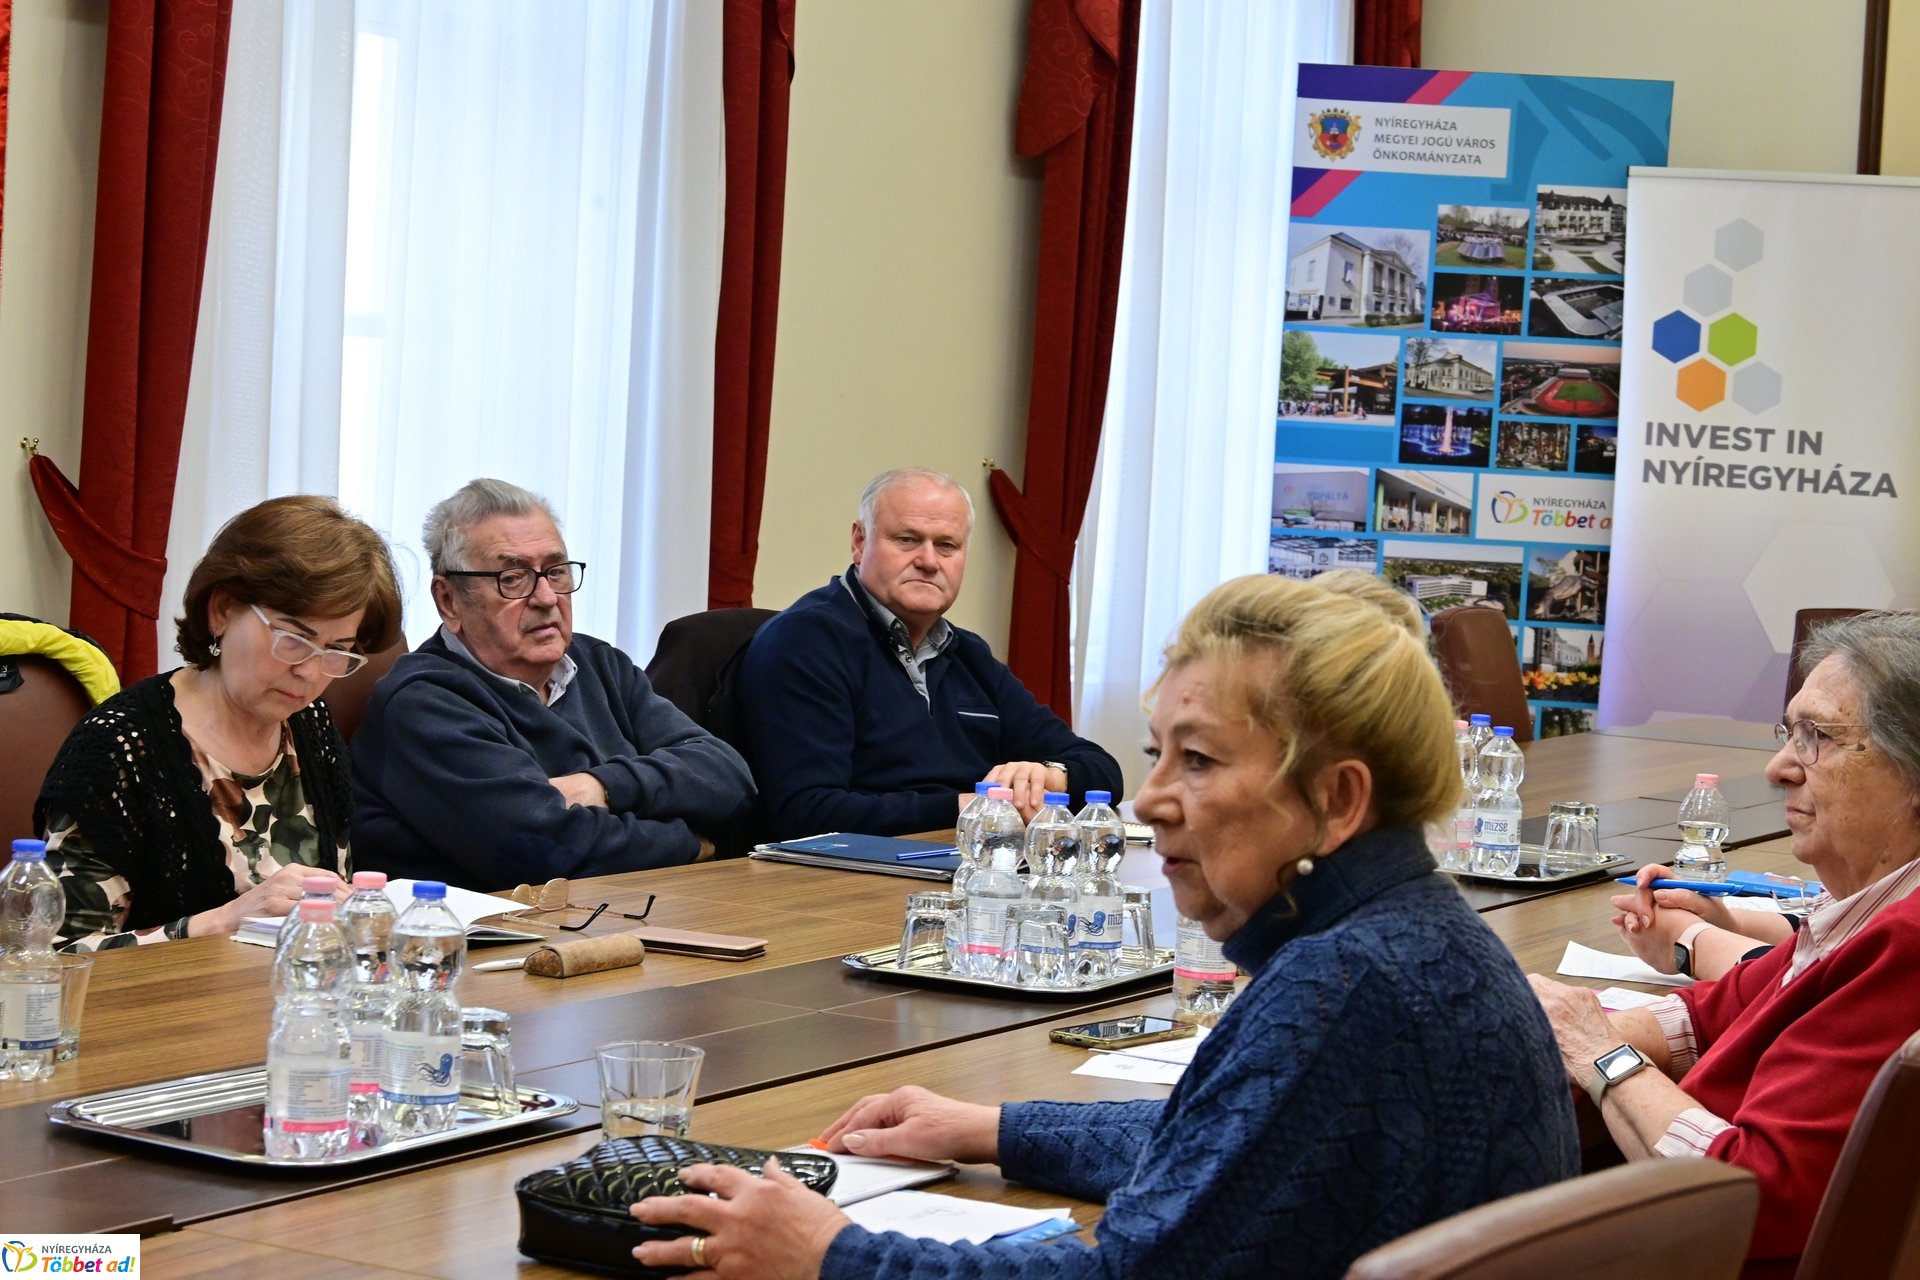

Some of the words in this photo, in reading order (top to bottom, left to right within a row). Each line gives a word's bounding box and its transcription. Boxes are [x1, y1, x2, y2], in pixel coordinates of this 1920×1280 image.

[1375, 116, 1457, 131] NYÍREGYHÁZA
[1374, 133, 1418, 145] MEGYEI
[1421, 135, 1453, 147] JOGÚ
[1456, 136, 1496, 149] VÁROS
[1373, 148, 1482, 164] ÖNKORMÁNYZATA
[1645, 421, 1775, 453] INVEST
[1786, 429, 1823, 456] IN
[1642, 455, 1898, 498] NYÍREGYHÁZA
[1533, 496, 1606, 509] NYÍREGYHÁZA
[1533, 509, 1596, 528] Többet
[1484, 821, 1508, 832] mizse
